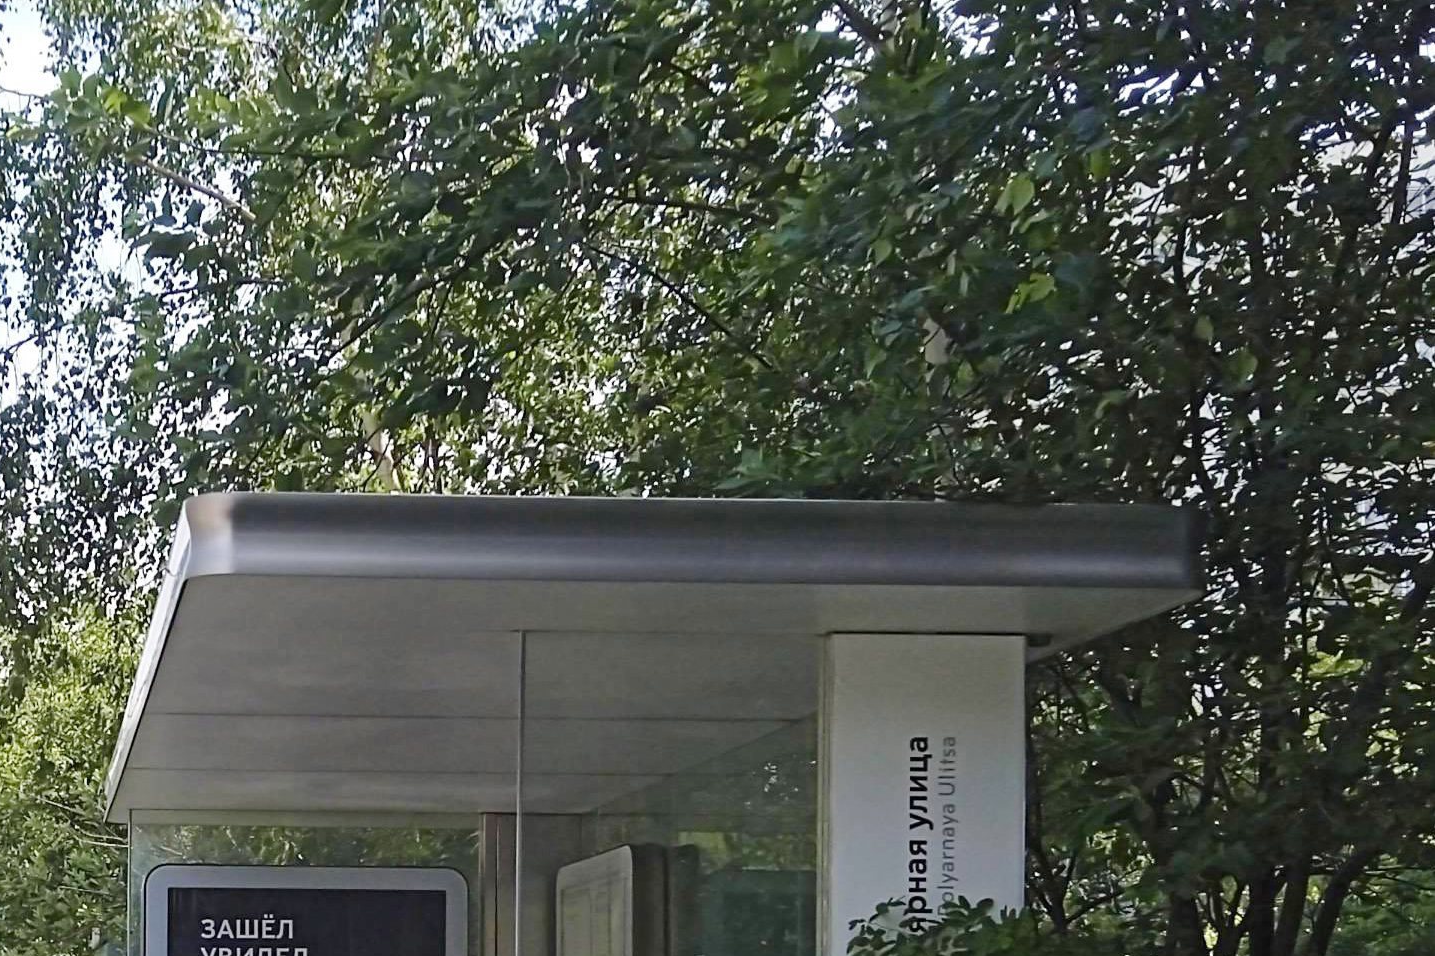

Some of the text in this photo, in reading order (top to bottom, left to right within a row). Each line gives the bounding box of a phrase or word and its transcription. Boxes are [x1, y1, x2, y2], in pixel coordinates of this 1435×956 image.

[937, 736, 956, 796] Ulitsa
[908, 736, 934, 933] ярная улица
[200, 913, 294, 939] ЗАШЁЛ
